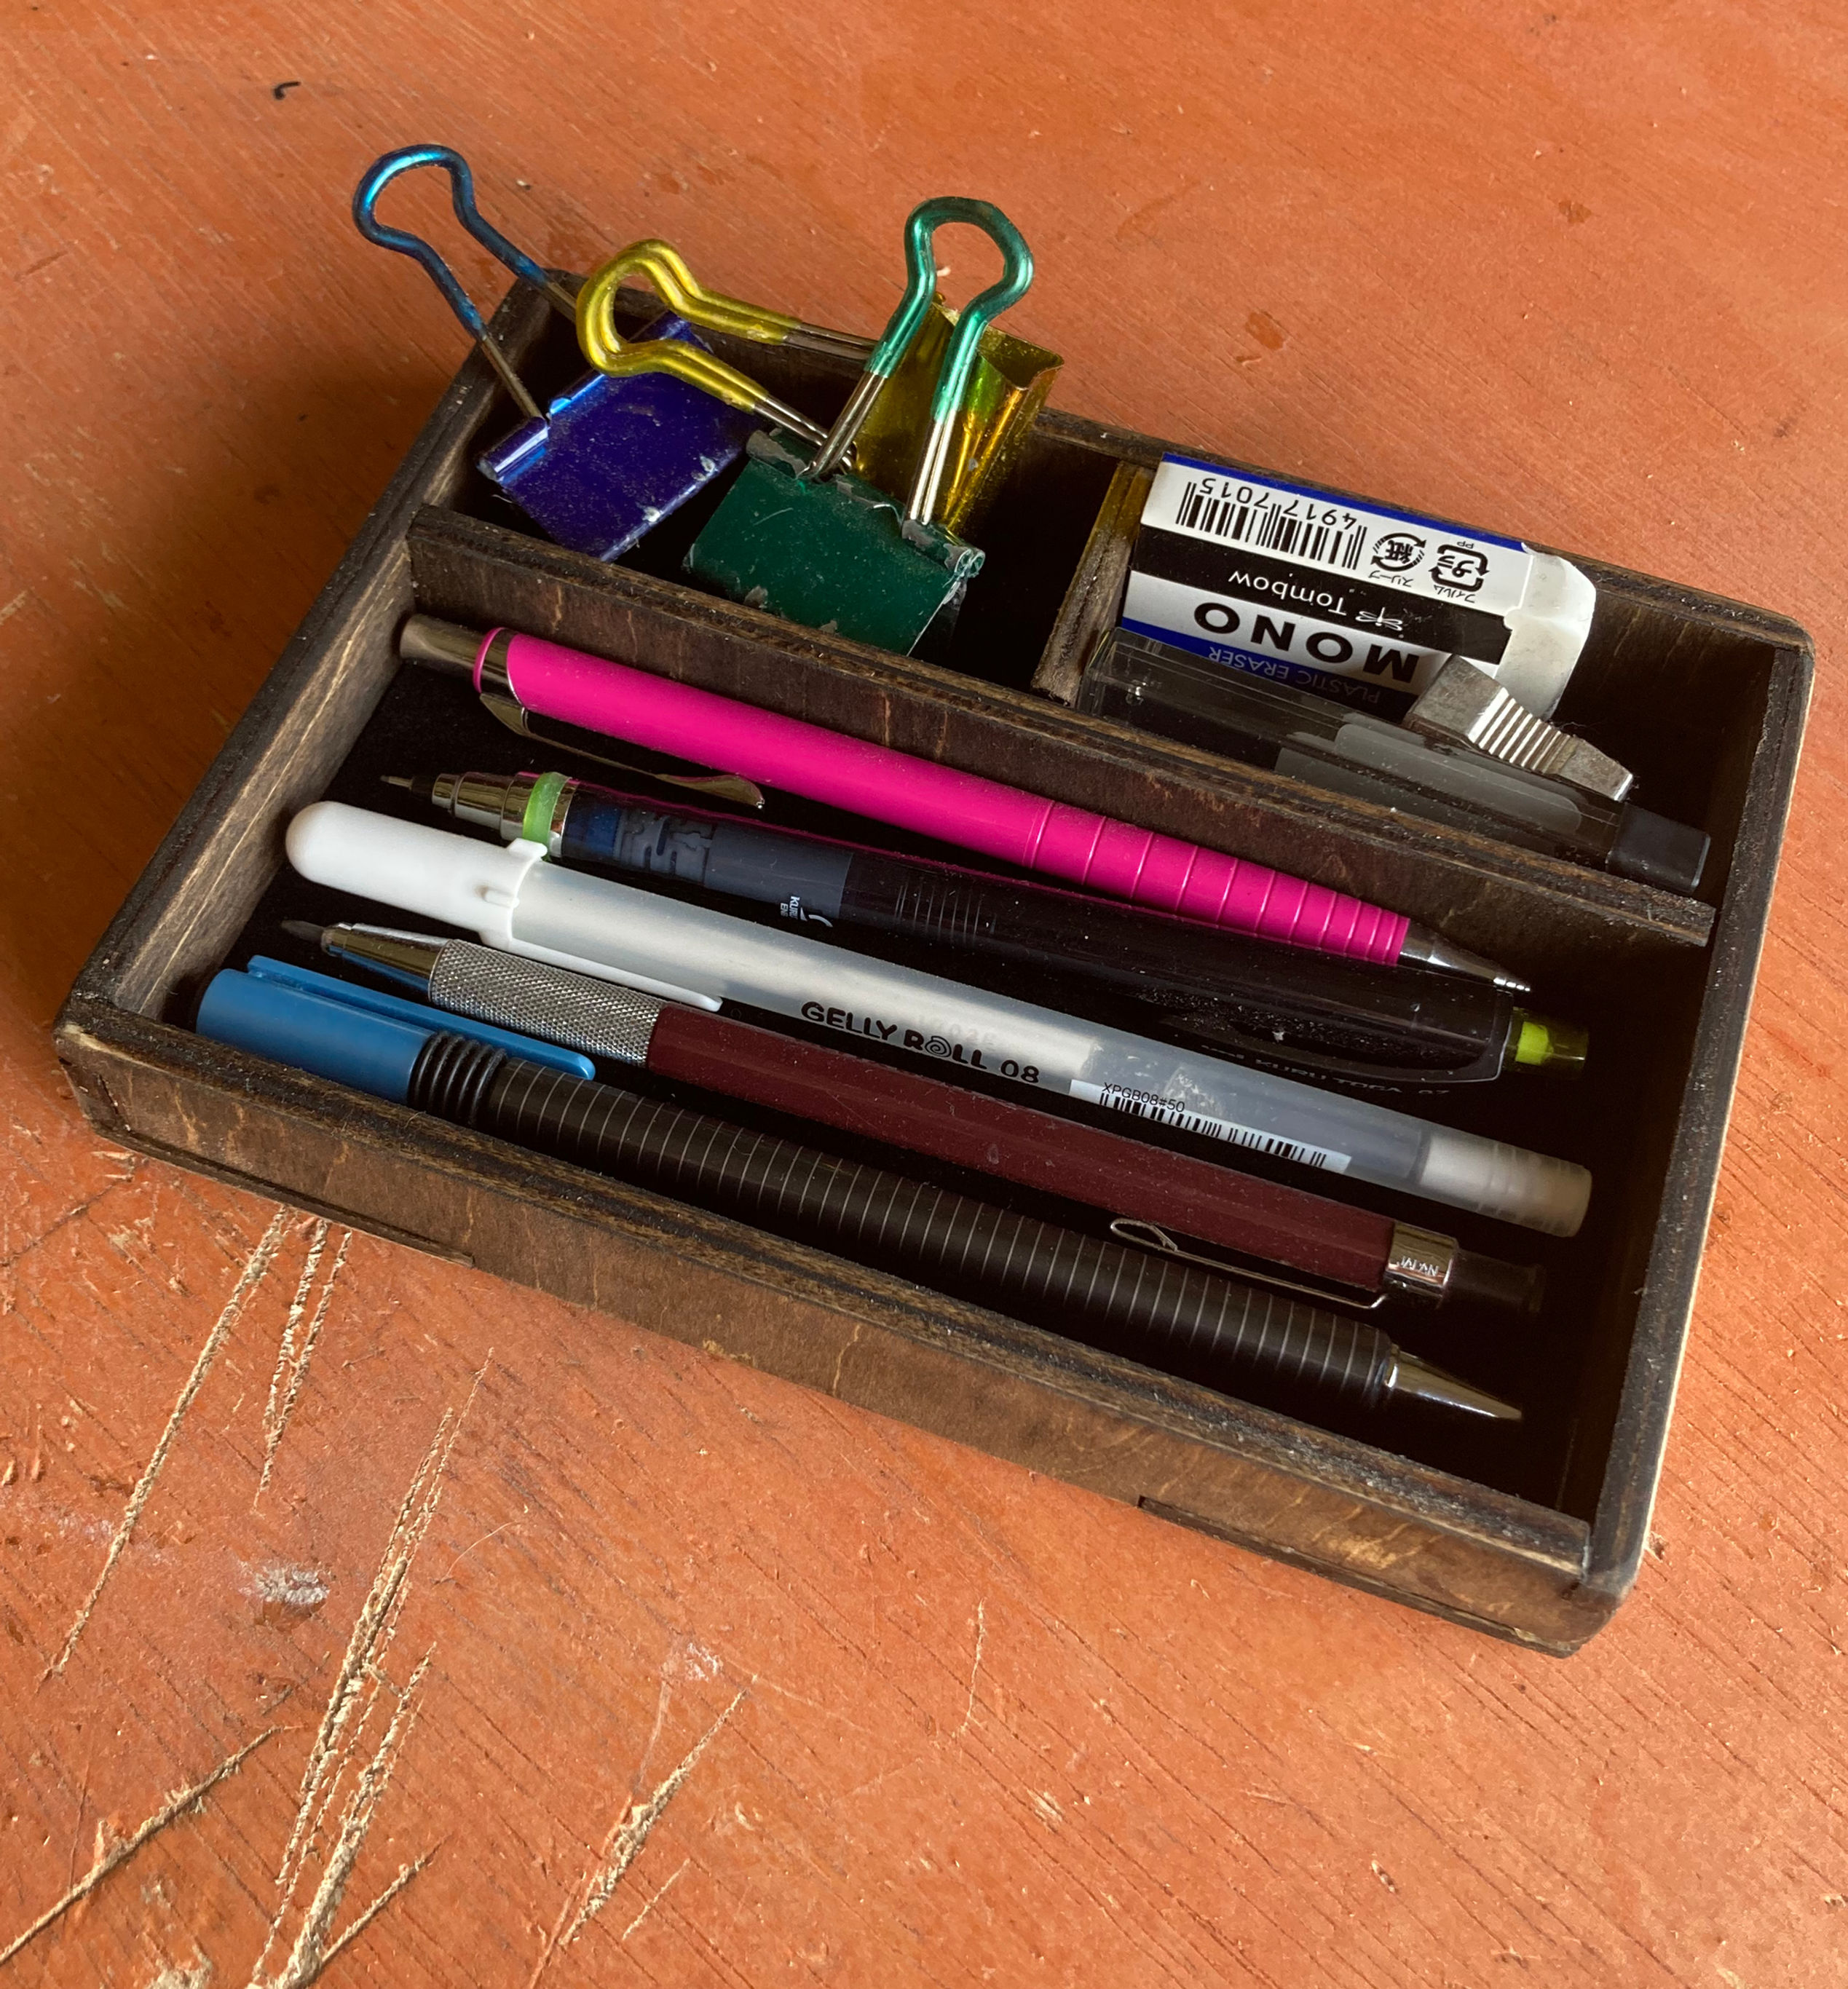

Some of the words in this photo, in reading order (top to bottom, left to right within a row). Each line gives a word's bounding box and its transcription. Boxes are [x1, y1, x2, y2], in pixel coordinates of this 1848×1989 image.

[1199, 478, 1270, 510] 7015
[1283, 499, 1357, 530] 4917
[1385, 539, 1414, 564] 紙
[1457, 541, 1474, 549] PP
[1437, 555, 1474, 577] プラ
[1228, 570, 1347, 616] Tombow
[1433, 584, 1476, 603] フィルム
[1193, 602, 1420, 683] MONO
[1208, 646, 1290, 679] ERASER
[1295, 668, 1381, 703] PLASTIC
[801, 1001, 898, 1040] GELLY
[903, 1029, 987, 1069] ROLL
[1000, 1060, 1040, 1083] 08
[1102, 1082, 1185, 1112] XPGB08#50
